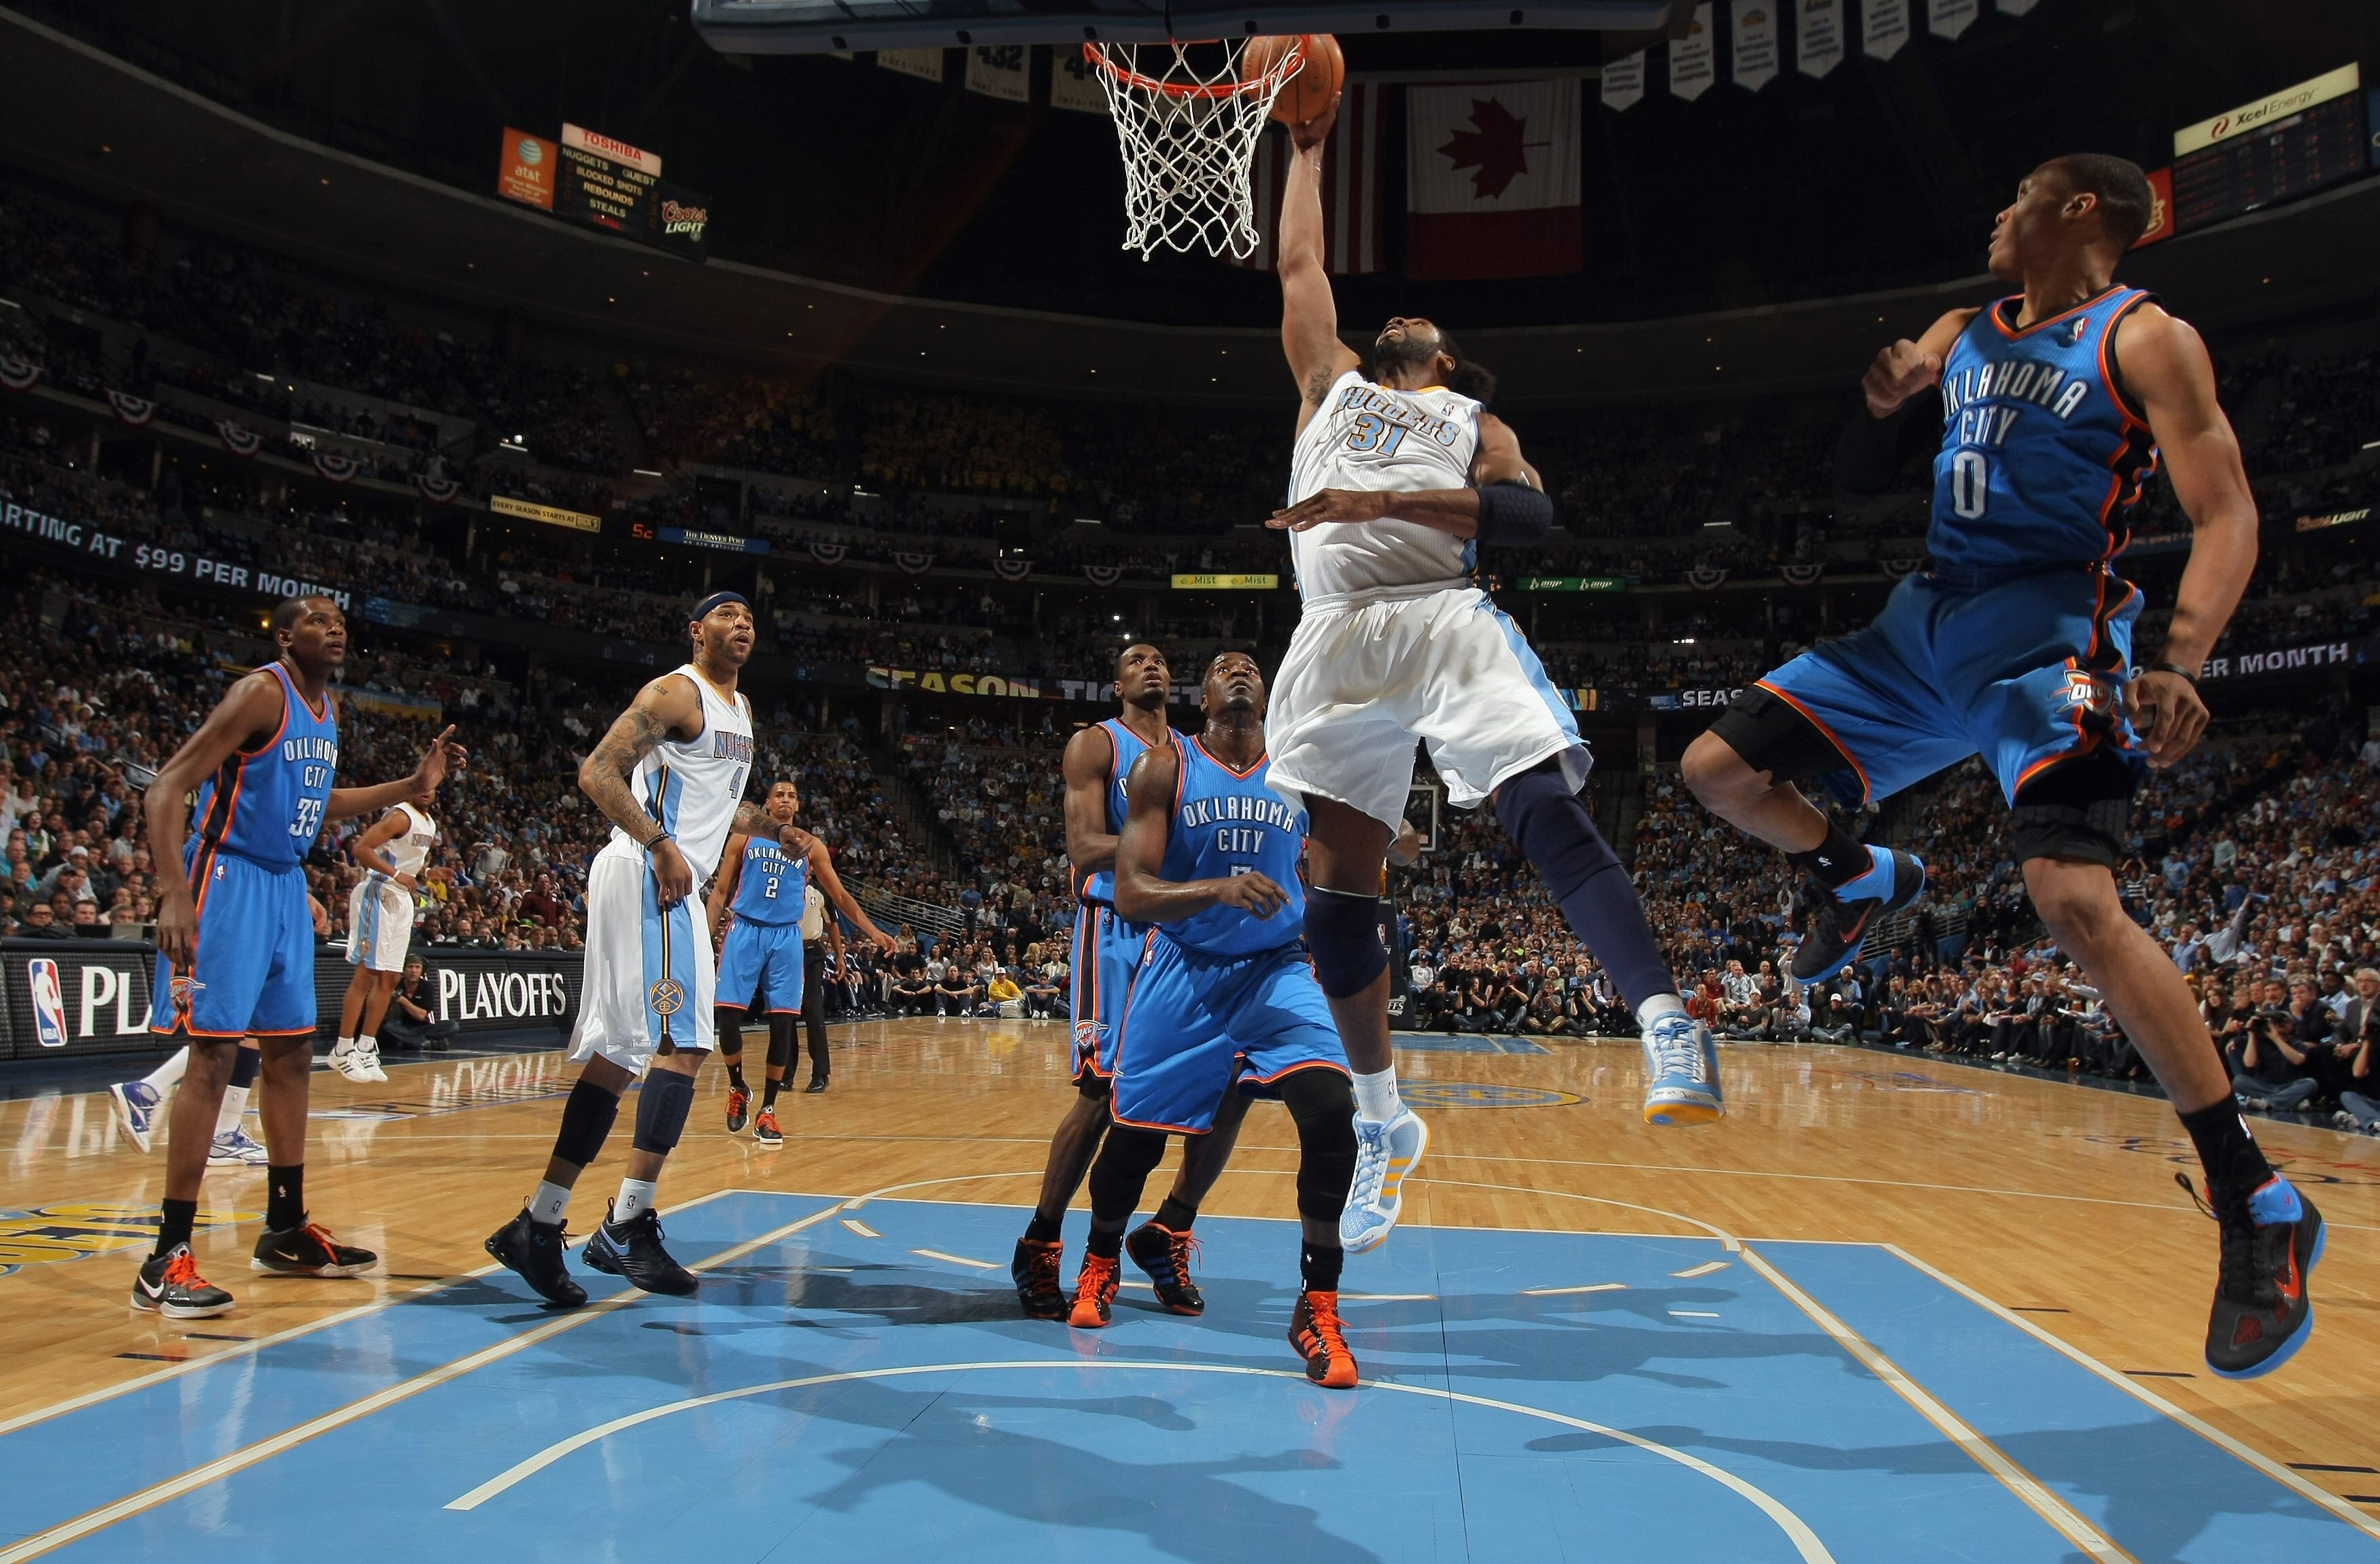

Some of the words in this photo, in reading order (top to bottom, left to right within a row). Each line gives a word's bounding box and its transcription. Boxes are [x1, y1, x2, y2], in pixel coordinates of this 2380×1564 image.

[582, 131, 642, 161] TOSHIBA
[515, 165, 541, 182] at&t
[562, 146, 609, 171] NUGGETS
[622, 168, 657, 186] GUEST
[576, 165, 614, 186] BLOCKED
[617, 180, 643, 196] SHOTS
[583, 182, 634, 207] REBOUNDS
[589, 198, 627, 218] STEALS
[662, 199, 708, 223] Coors
[665, 222, 705, 234] LIGHT
[1942, 360, 2088, 420] OKLAHOMA
[1333, 386, 1461, 446] NUGGETS
[1960, 405, 2020, 445] CITY
[1346, 413, 1408, 458] 31
[1954, 449, 1989, 520] 0
[492, 500, 513, 511] EVERY
[515, 505, 541, 516] SEASON
[543, 511, 566, 520] STARTS
[2332, 509, 2371, 524] LIGHT
[88, 532, 122, 559] AT
[135, 543, 186, 573] $99
[195, 558, 248, 588] PER
[258, 573, 351, 611] MONTH
[1194, 576, 1216, 584] Mist
[1244, 576, 1266, 584] Mist
[2202, 658, 2230, 679] ER
[2240, 643, 2349, 675] MONTH
[305, 766, 328, 788] CTY
[729, 767, 744, 799] 4
[289, 798, 322, 838] 35
[1182, 796, 1294, 834] OKLAHOMA
[1217, 828, 1264, 853] CITY
[762, 861, 786, 877] CITY
[765, 877, 779, 899] 2
[438, 968, 566, 1021] PLAYOFFS
